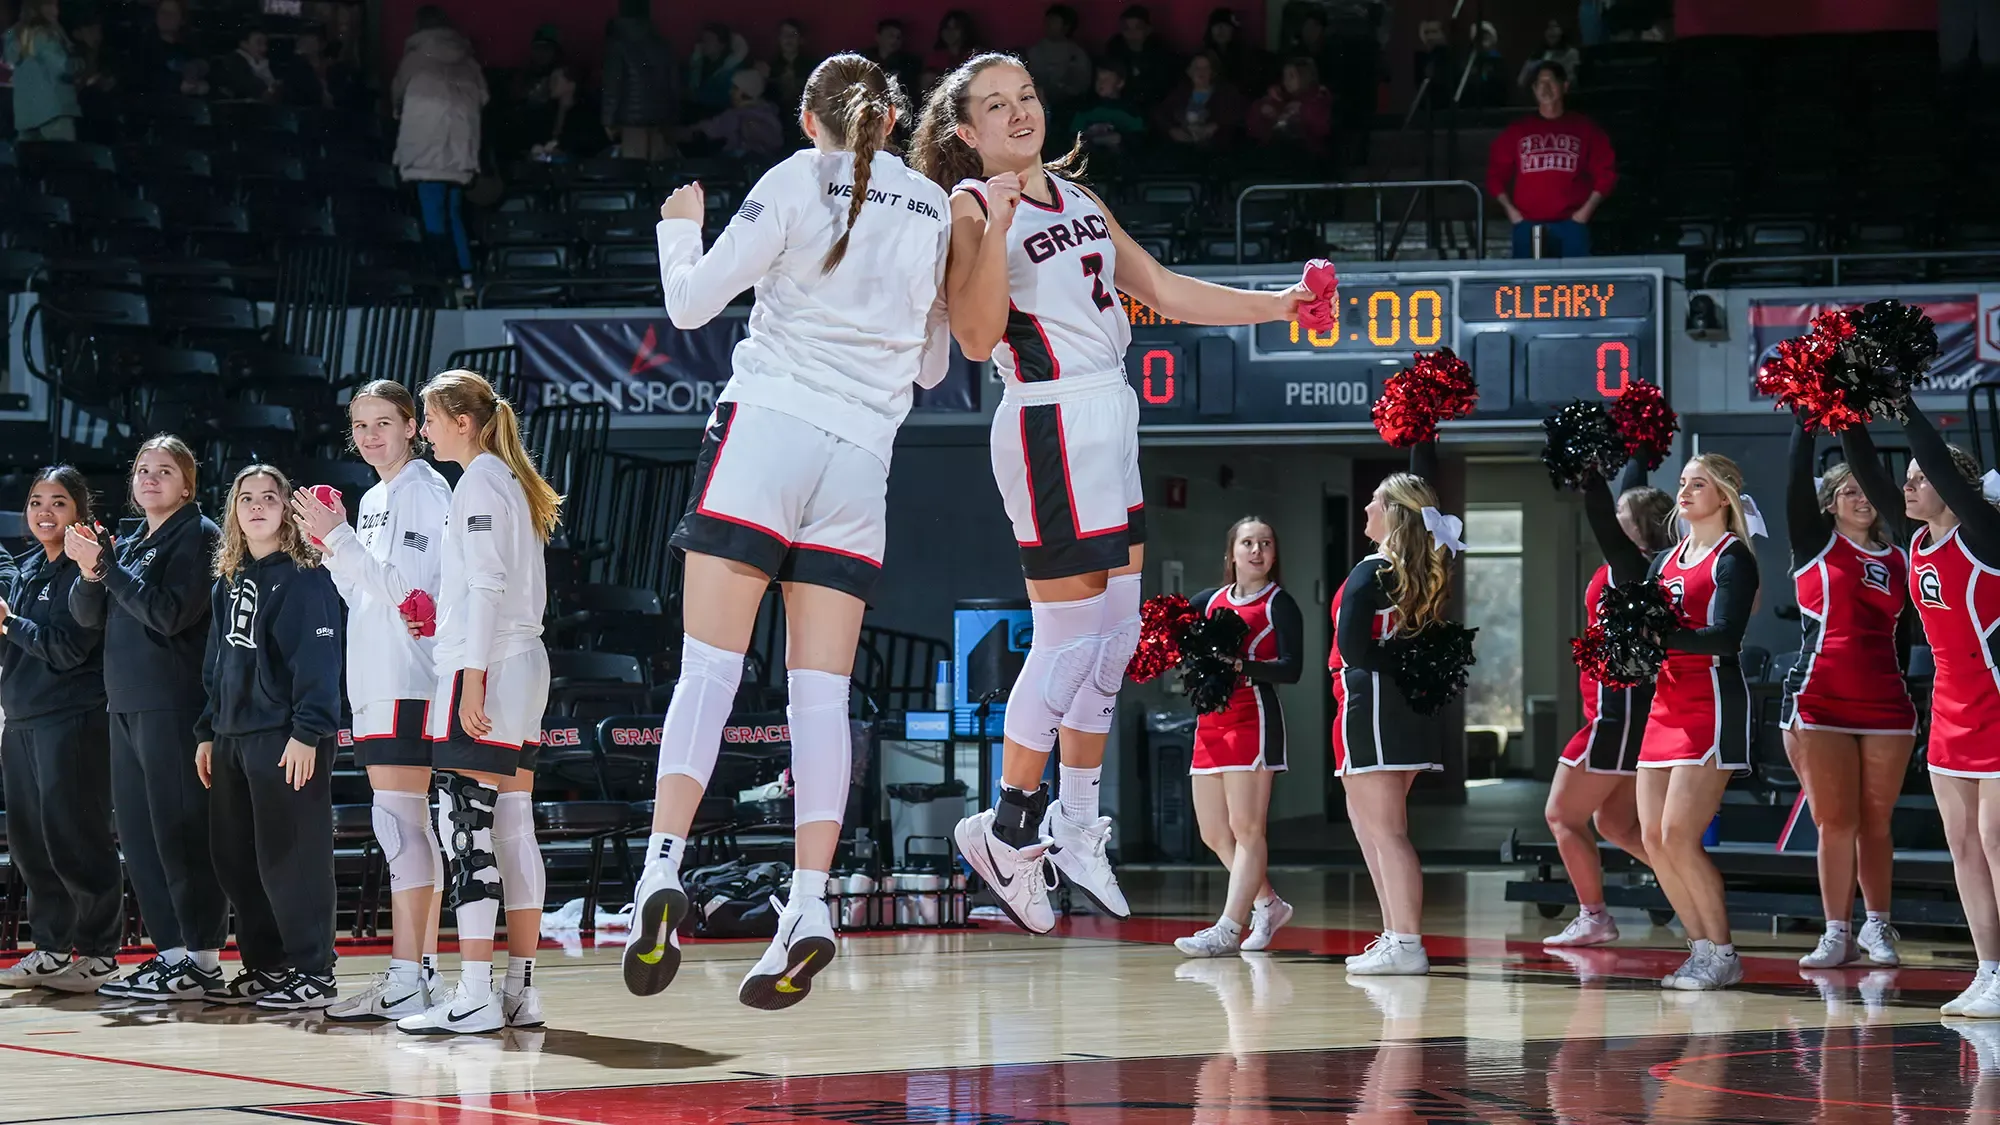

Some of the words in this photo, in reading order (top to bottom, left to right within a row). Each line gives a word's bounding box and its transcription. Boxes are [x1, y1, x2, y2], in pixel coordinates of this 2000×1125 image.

[827, 182, 853, 197] WE
[866, 188, 901, 206] ON'T
[1080, 252, 1114, 313] 2
[1495, 283, 1615, 319] CLEARY
[1143, 350, 1175, 404] 0
[1596, 341, 1630, 397] 0
[542, 381, 623, 412] BSN
[1285, 382, 1369, 406] PERIOD
[539, 728, 579, 747] ACE
[612, 728, 664, 746] GRAC
[724, 725, 791, 743] GRACE
